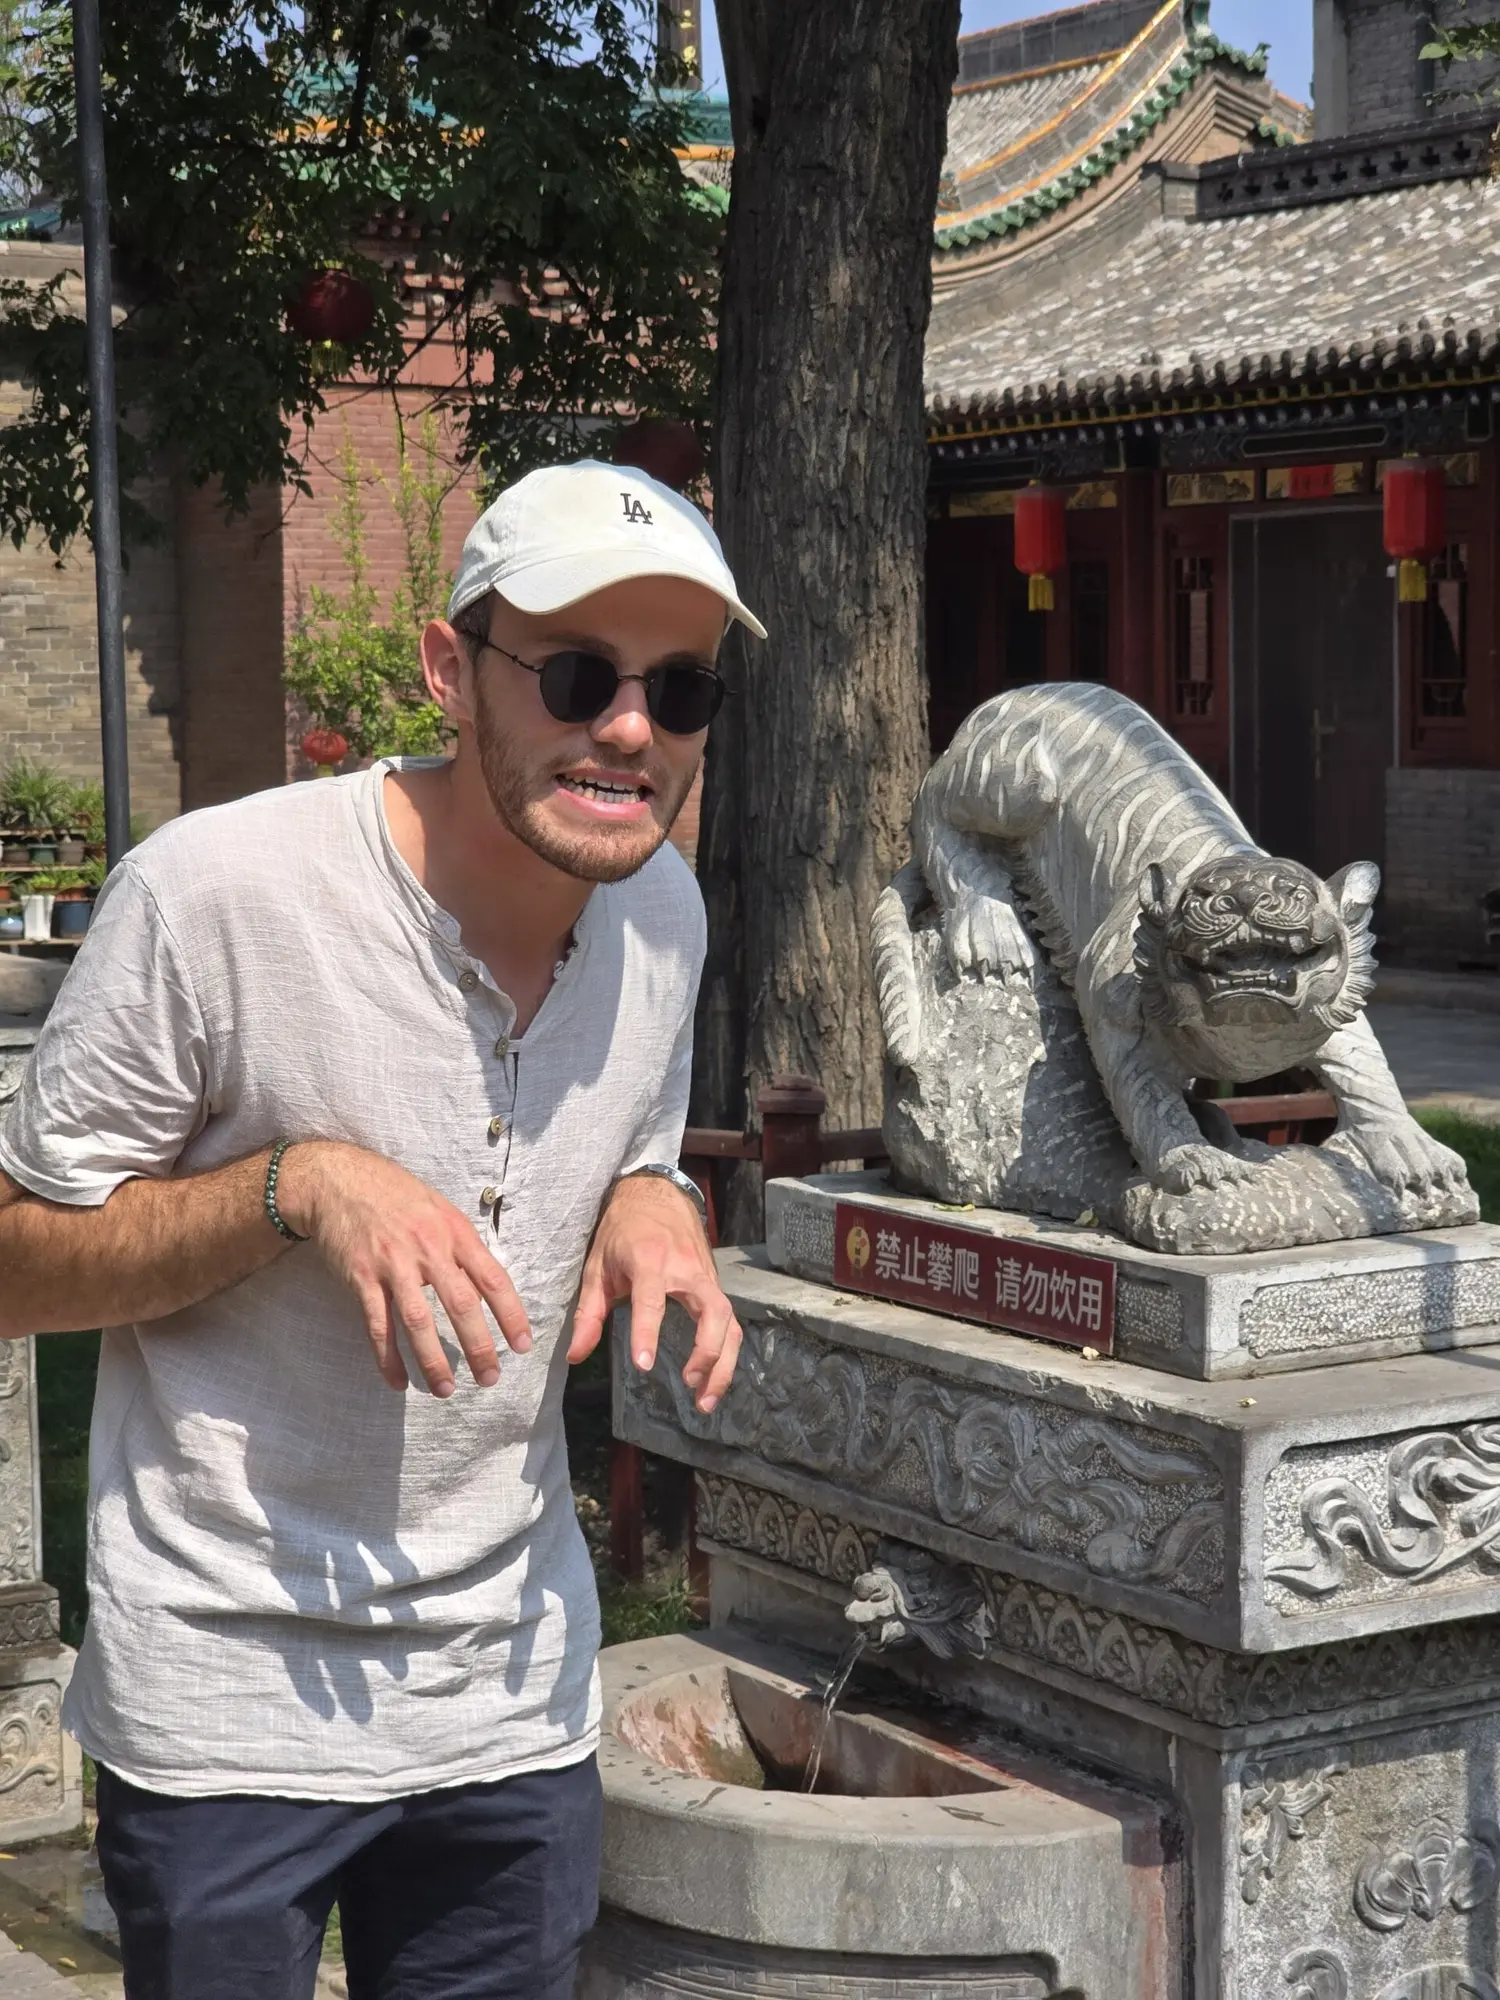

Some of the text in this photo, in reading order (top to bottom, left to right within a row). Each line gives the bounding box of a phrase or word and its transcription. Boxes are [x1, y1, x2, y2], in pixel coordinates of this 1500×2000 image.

[620, 493, 653, 525] LA
[875, 1229, 979, 1300] 禁止攀爬
[995, 1257, 1103, 1331] 请勿饮用
